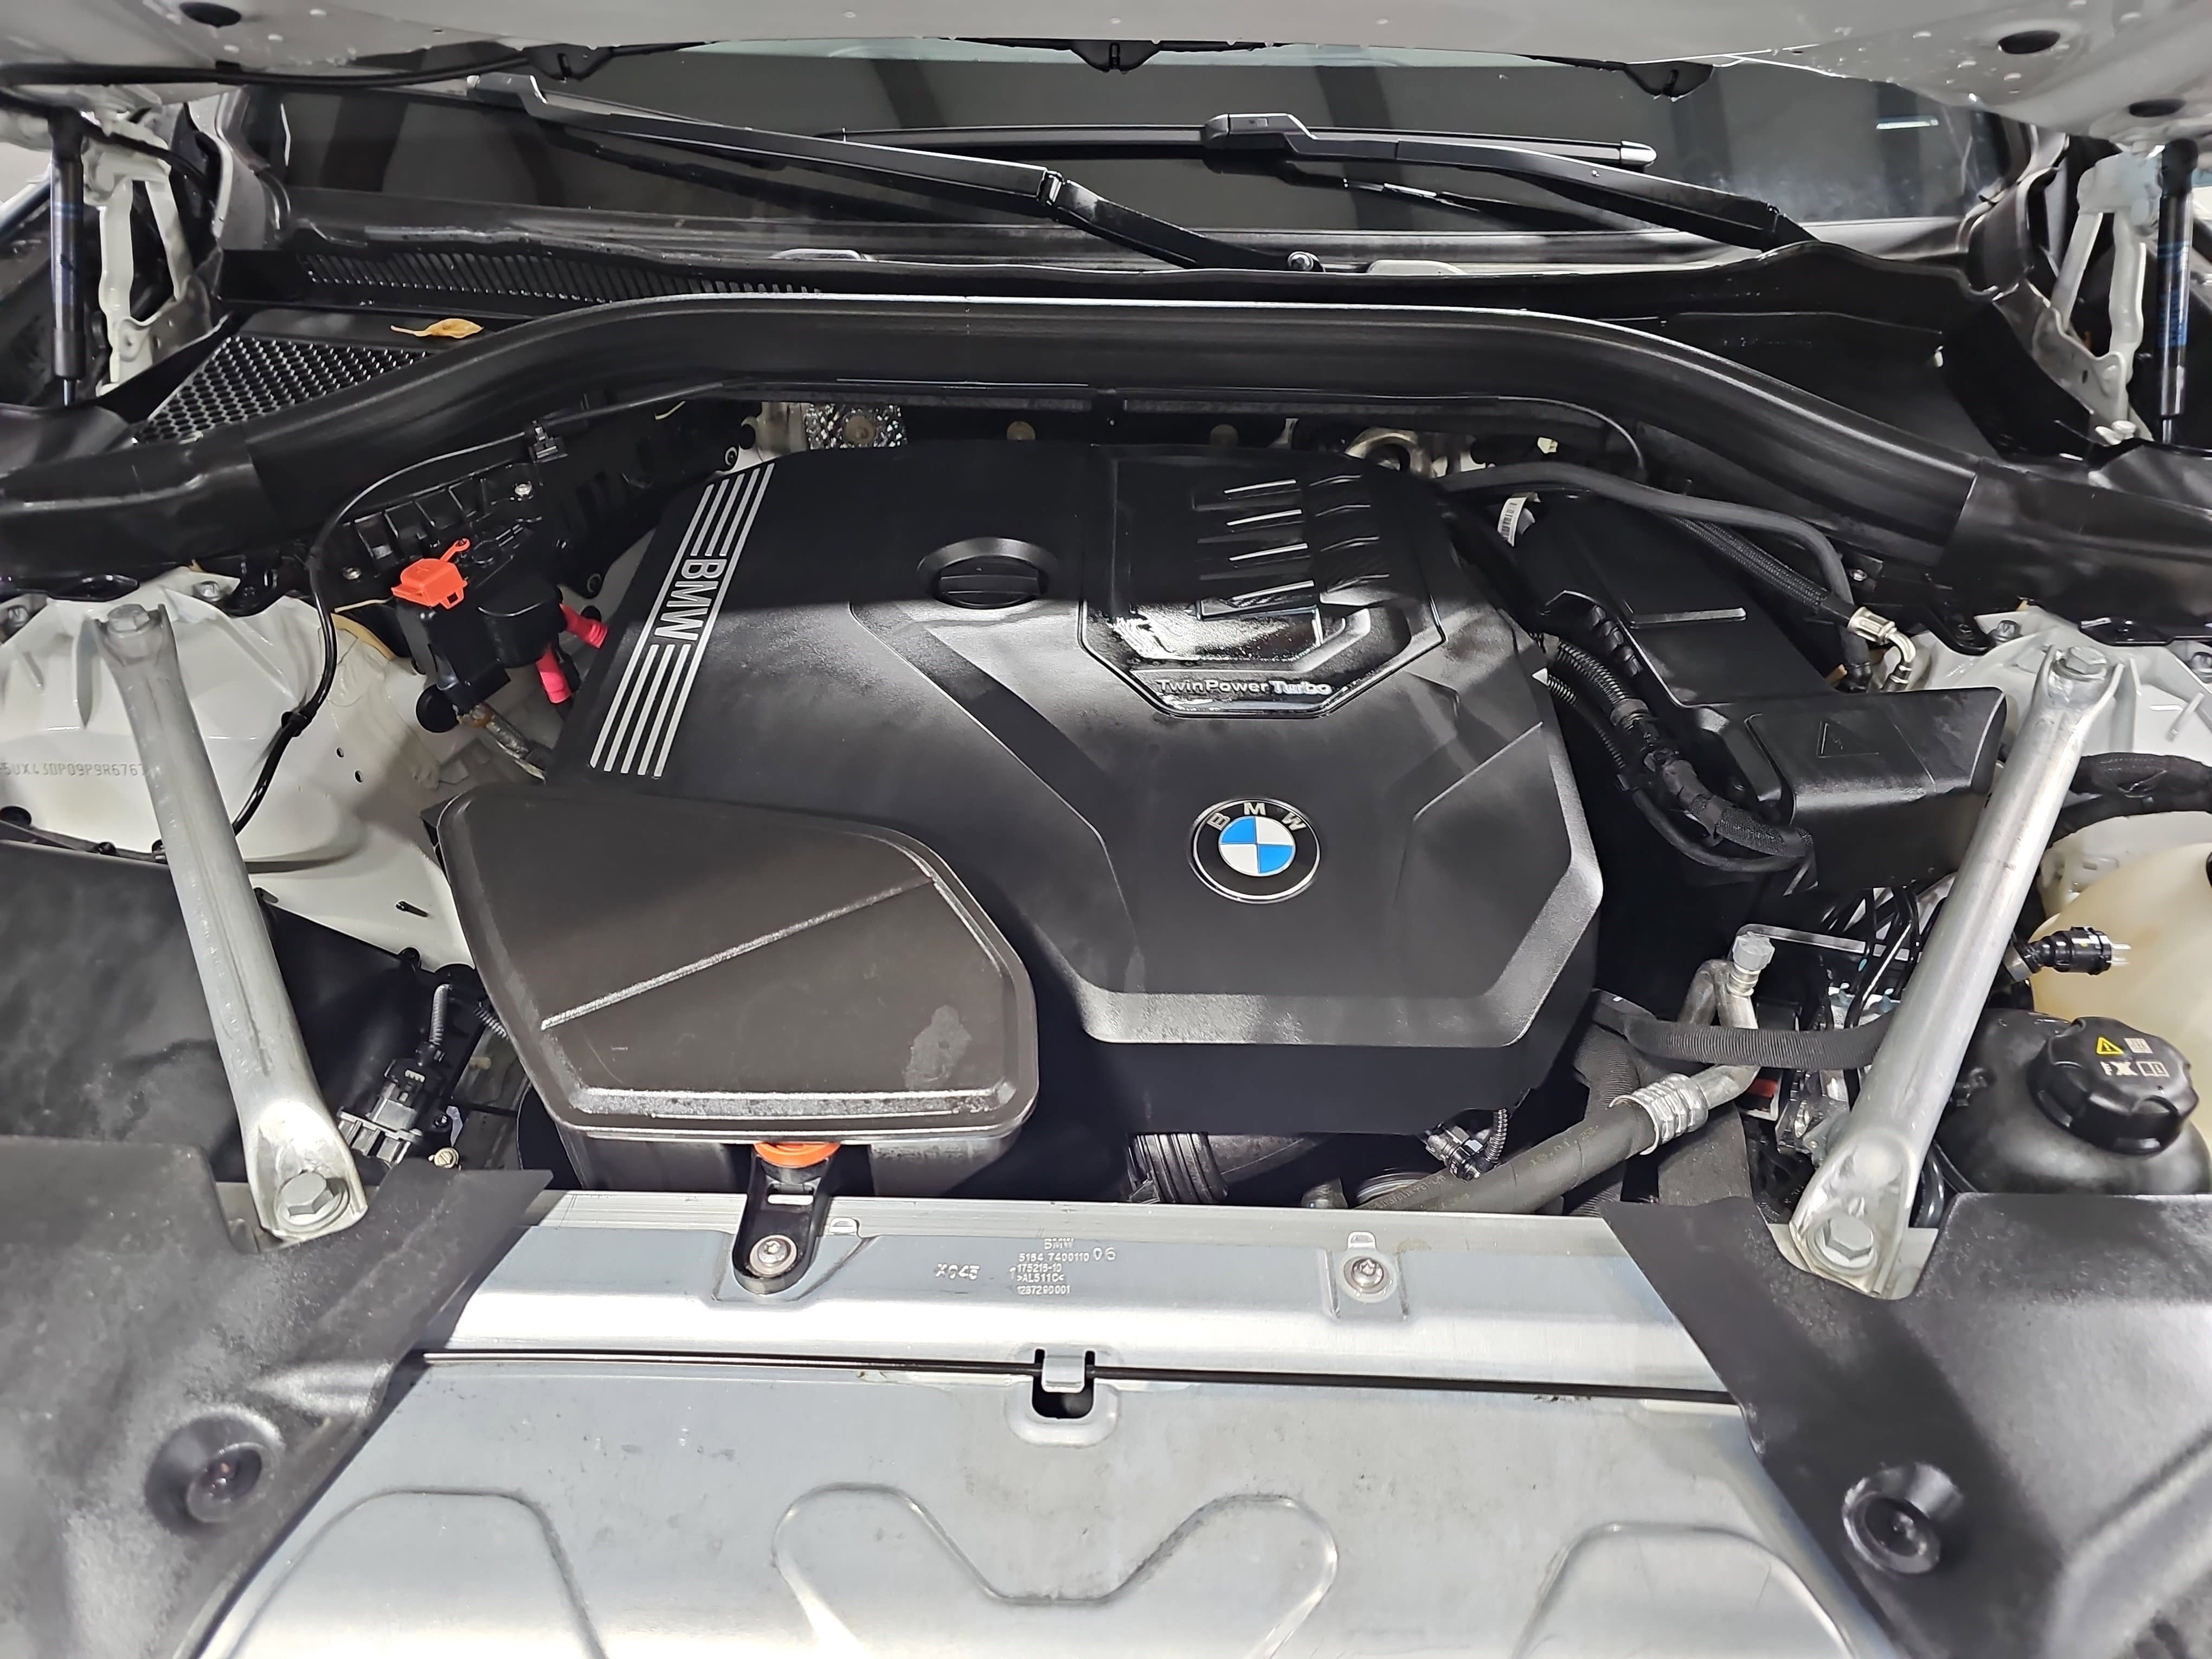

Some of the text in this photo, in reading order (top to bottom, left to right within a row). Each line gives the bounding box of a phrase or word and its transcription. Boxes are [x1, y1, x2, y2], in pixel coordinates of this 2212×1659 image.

[654, 558, 728, 641] BMW
[1270, 680, 1333, 695] Turbo
[1207, 802, 1307, 831] BMW
[1044, 1238, 1075, 1250] BMW
[1047, 1252, 1089, 1262] 7400110
